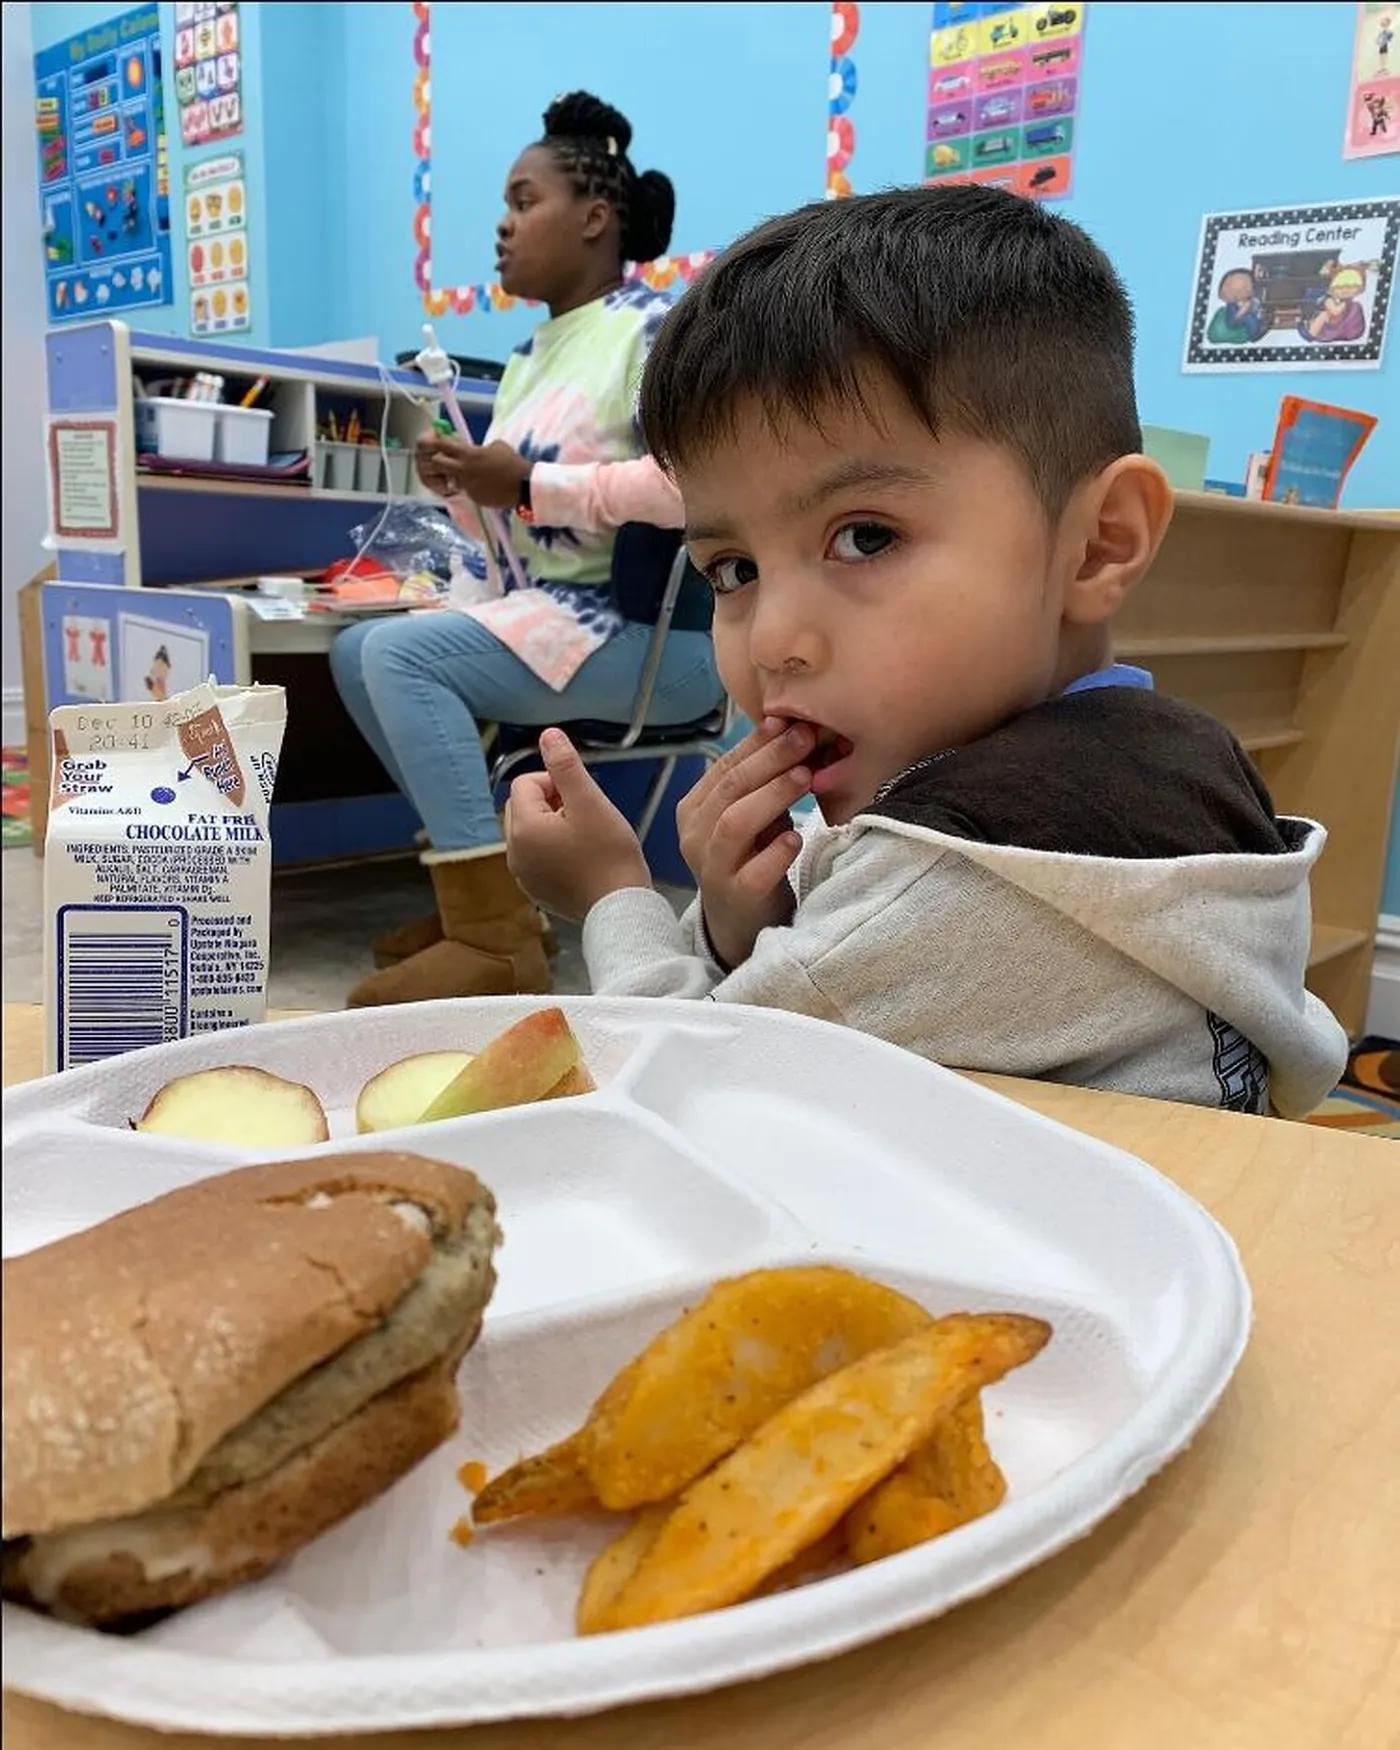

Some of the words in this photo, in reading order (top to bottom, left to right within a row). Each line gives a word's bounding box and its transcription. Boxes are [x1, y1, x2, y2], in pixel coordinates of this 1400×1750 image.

[1238, 230, 1300, 248] Reading
[1305, 226, 1362, 243] Center
[62, 760, 107, 770] Grab
[62, 771, 103, 781] Your
[61, 783, 113, 793] Straw
[188, 814, 217, 824] FAT
[126, 825, 221, 841] CHOCOLATE
[225, 827, 264, 841] MILK
[163, 949, 179, 997] 11517
